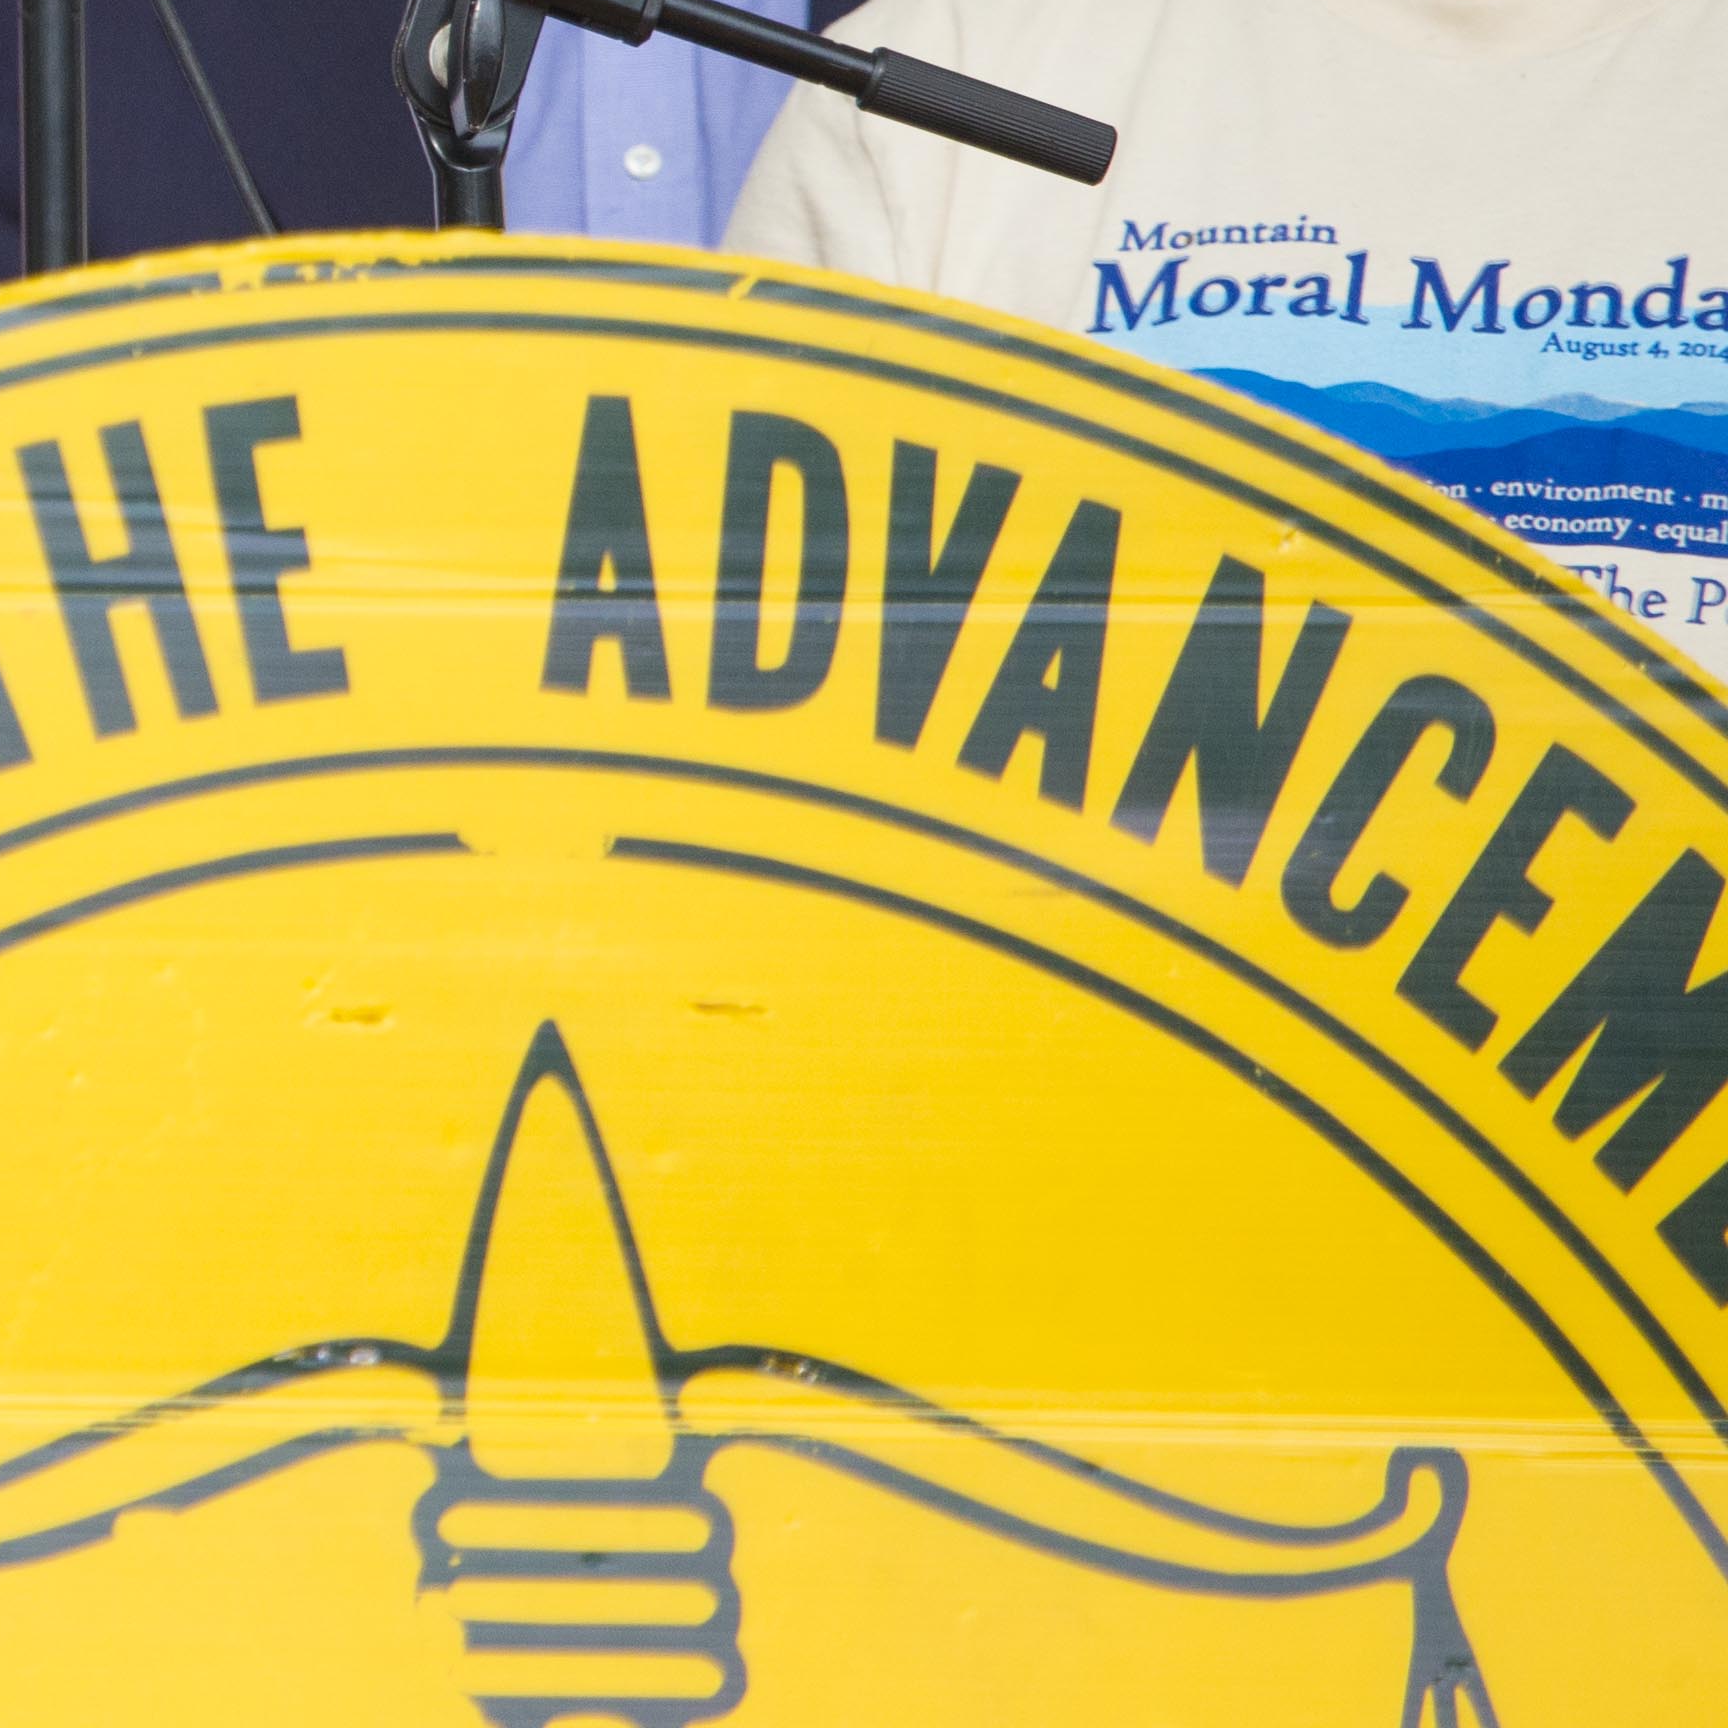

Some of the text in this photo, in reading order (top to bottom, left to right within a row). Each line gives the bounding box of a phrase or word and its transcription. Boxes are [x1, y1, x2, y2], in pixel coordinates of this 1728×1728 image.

[1117, 214, 1340, 252] Mountain
[1085, 249, 1728, 335] Moral Monda
[1540, 331, 1728, 364] August 4, 2014
[1490, 478, 1676, 506] environment
[1504, 514, 1728, 548] economy equal
